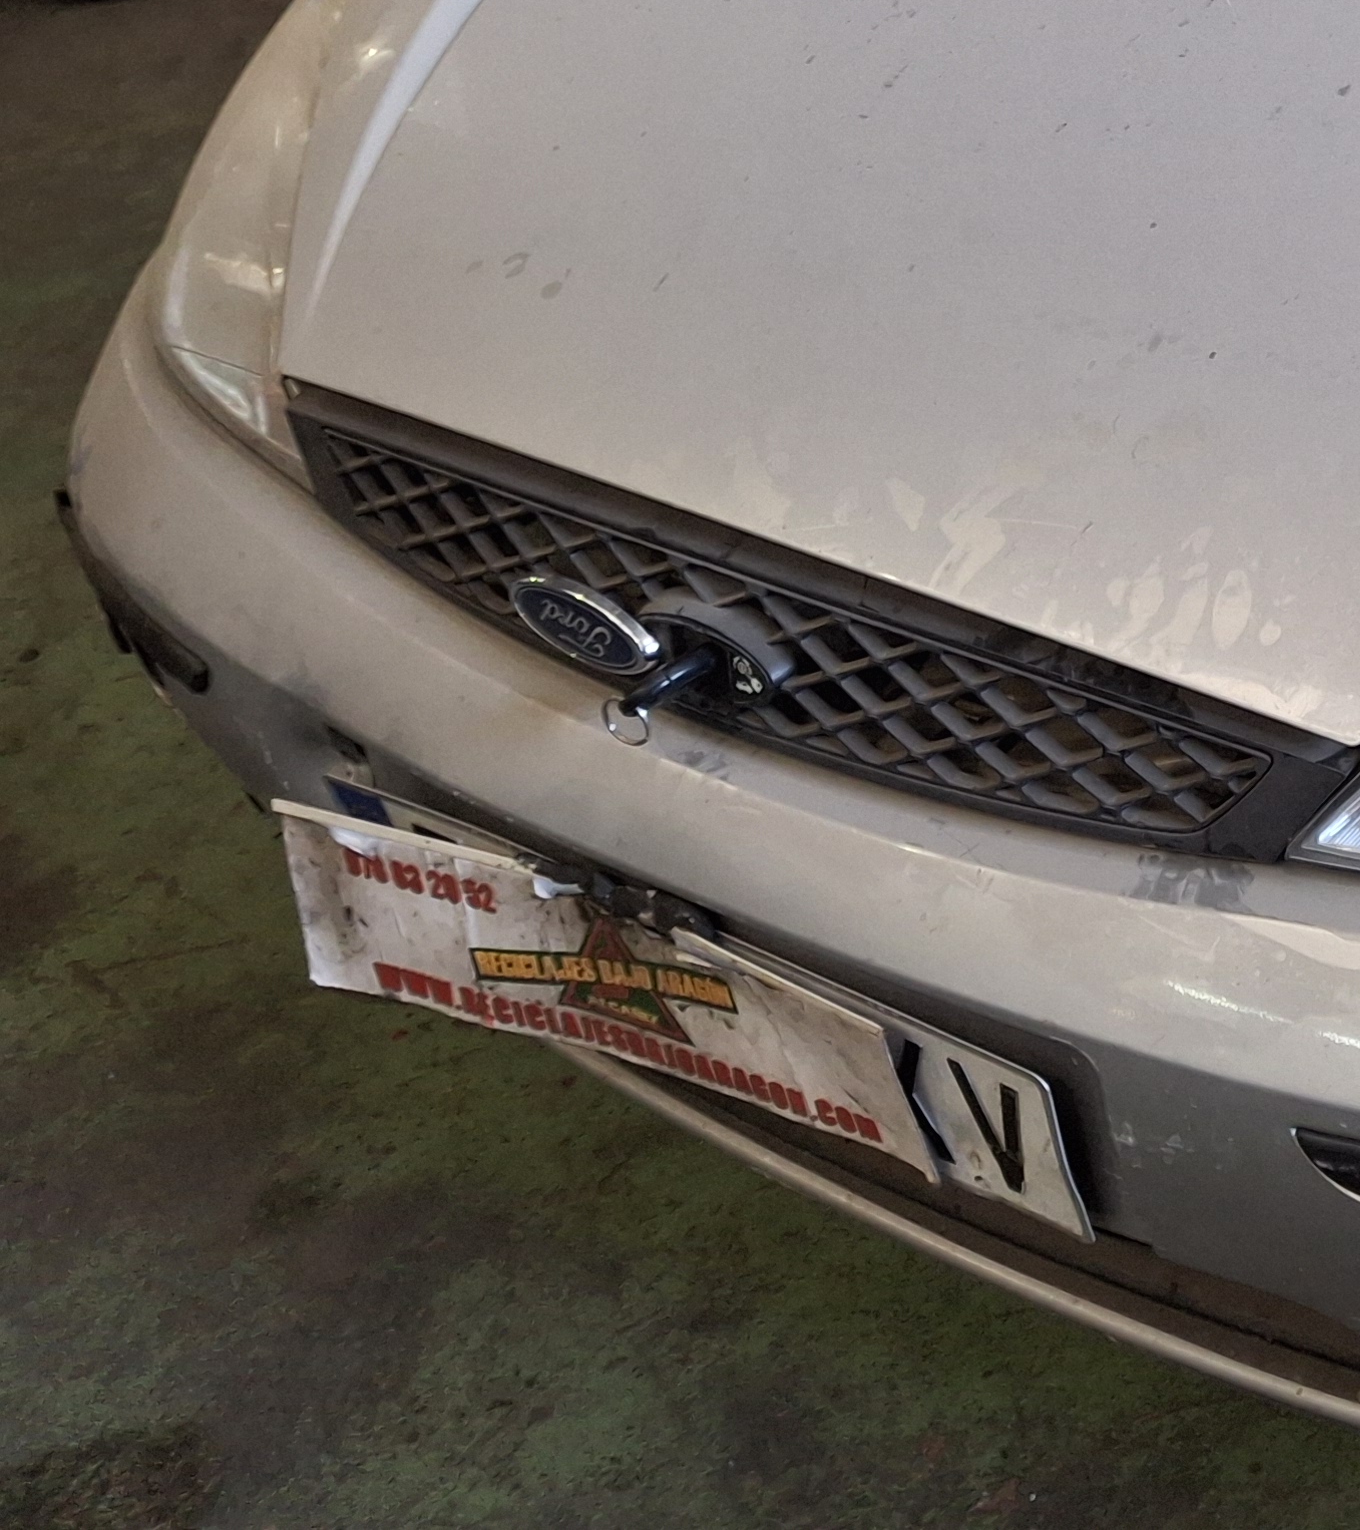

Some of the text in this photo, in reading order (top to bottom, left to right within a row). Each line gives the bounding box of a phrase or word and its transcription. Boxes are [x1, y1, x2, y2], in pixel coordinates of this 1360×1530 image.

[540, 599, 612, 658] Ford
[474, 949, 598, 983] RECICLAJES
[596, 958, 653, 989] BAJO
